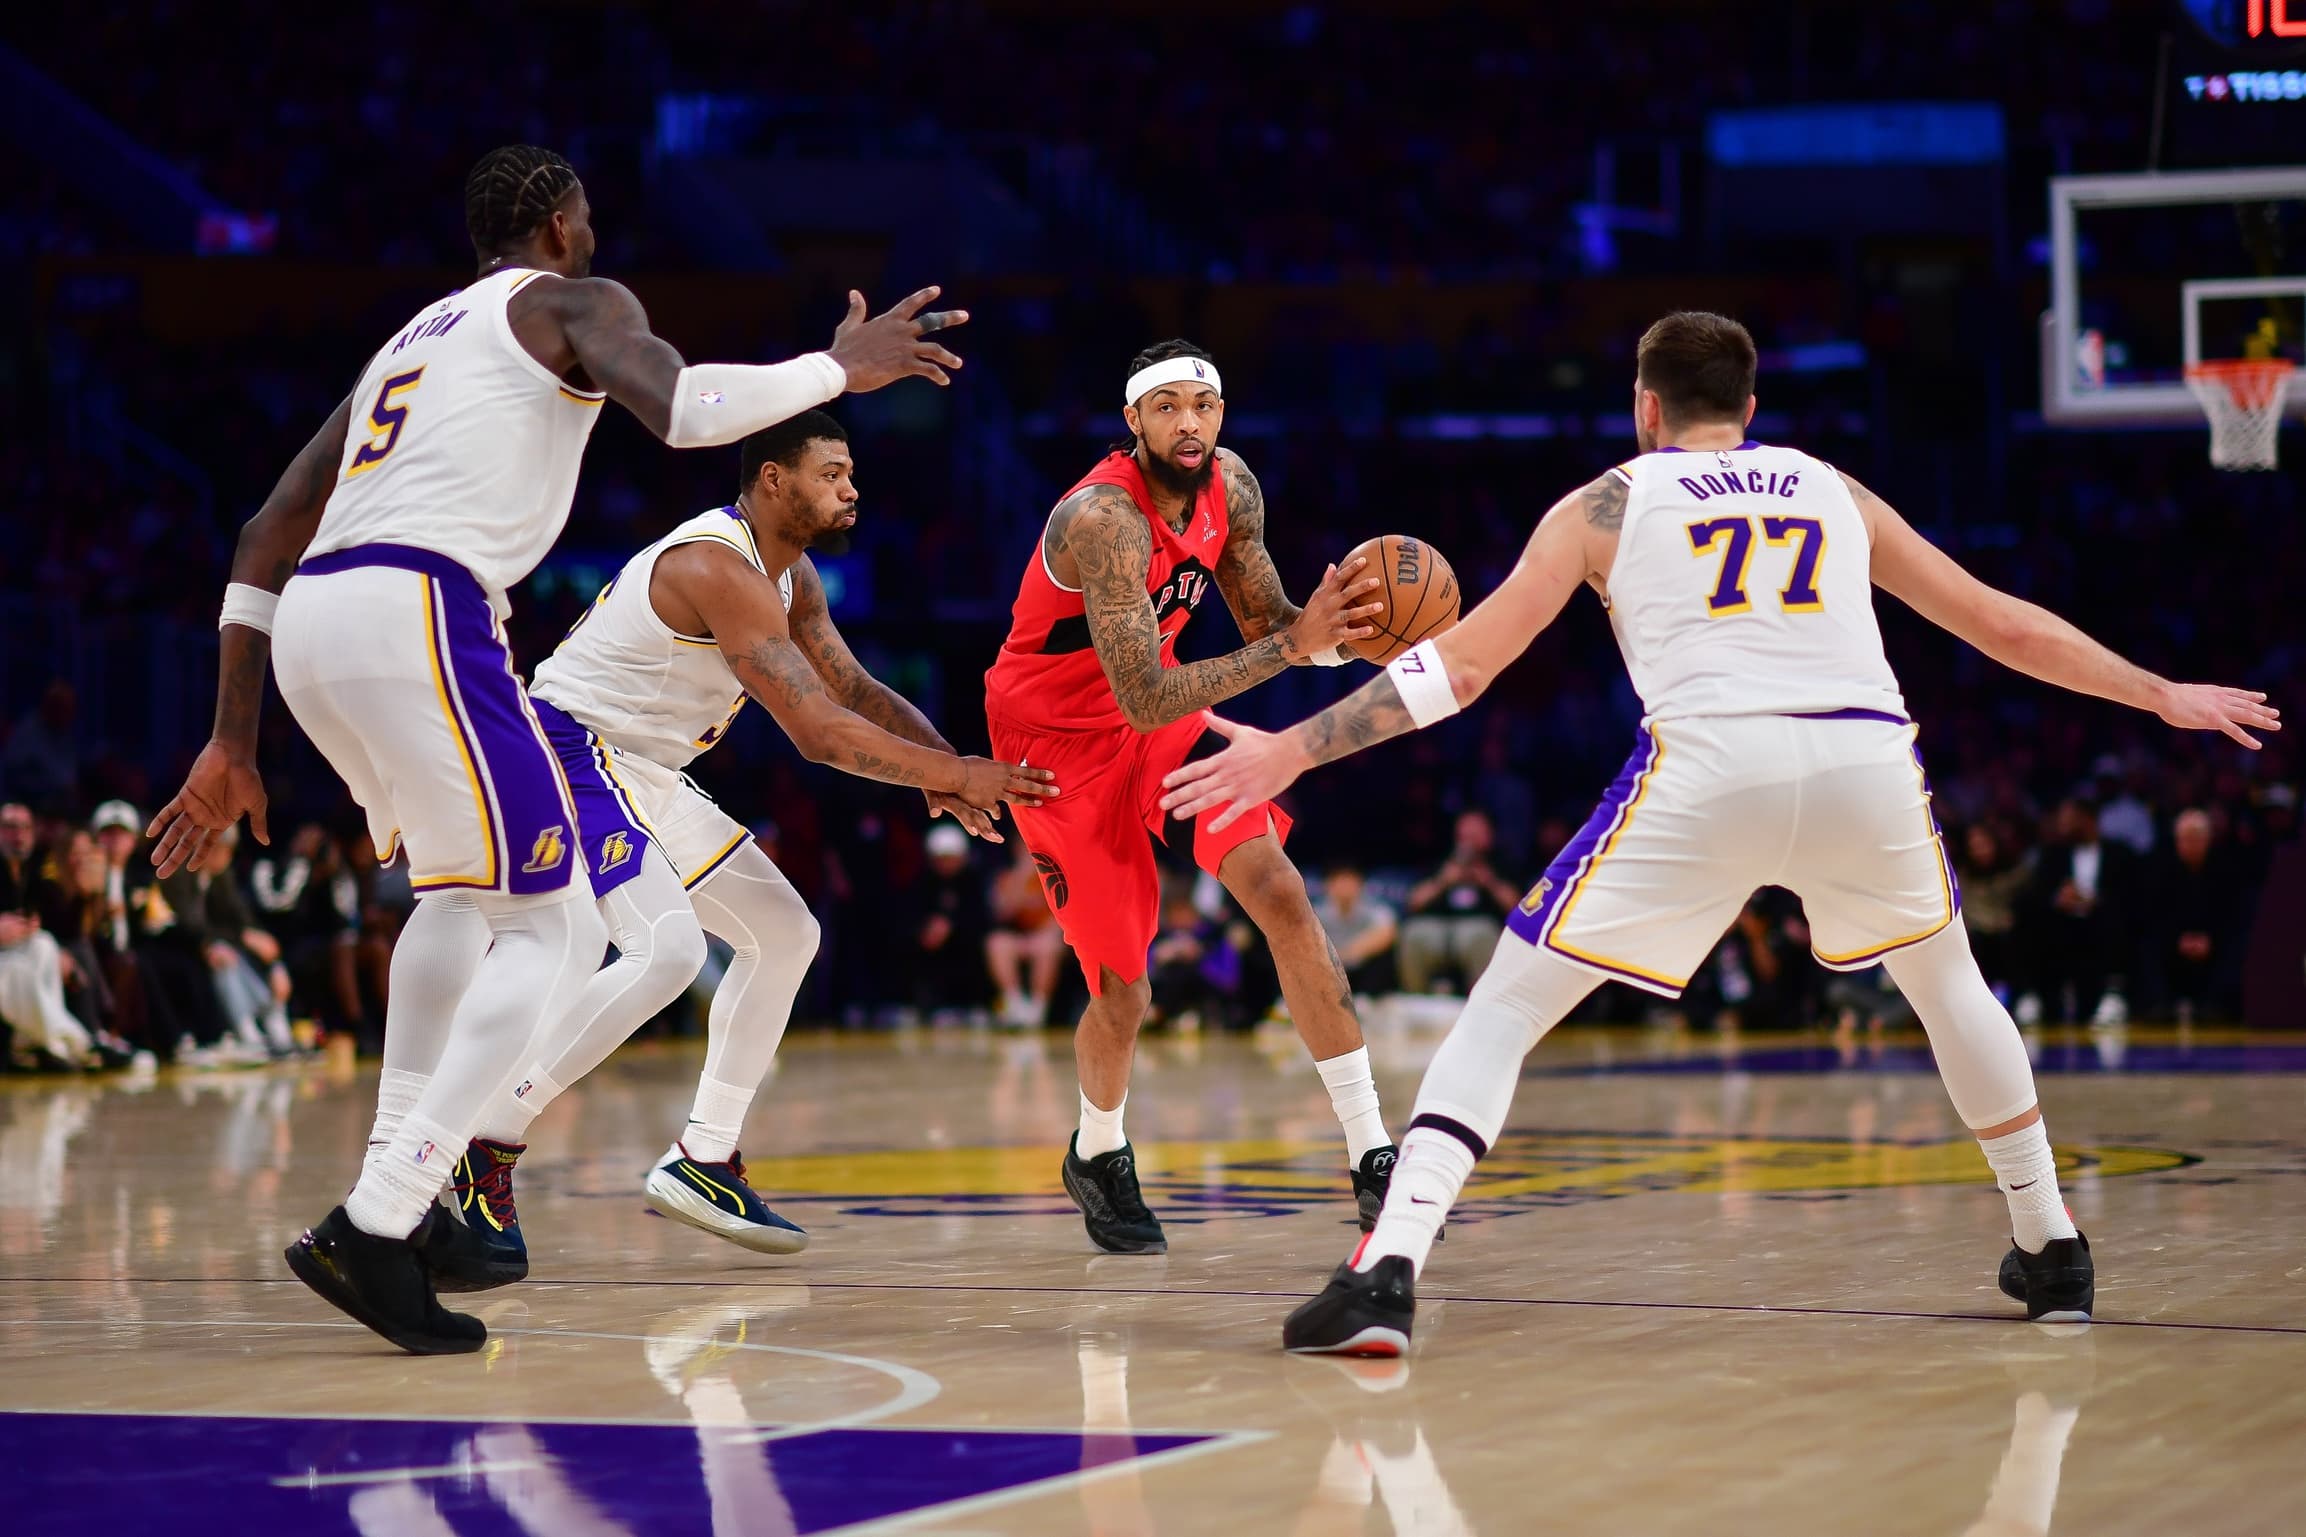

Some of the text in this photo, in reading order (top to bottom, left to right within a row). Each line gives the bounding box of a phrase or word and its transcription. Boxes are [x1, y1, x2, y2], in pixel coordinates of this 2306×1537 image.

[391, 310, 469, 355] AYTON
[344, 362, 429, 479] 5
[1677, 468, 1801, 501] DONČIĆ
[1683, 513, 1828, 618] 77
[1398, 651, 1426, 675] 77
